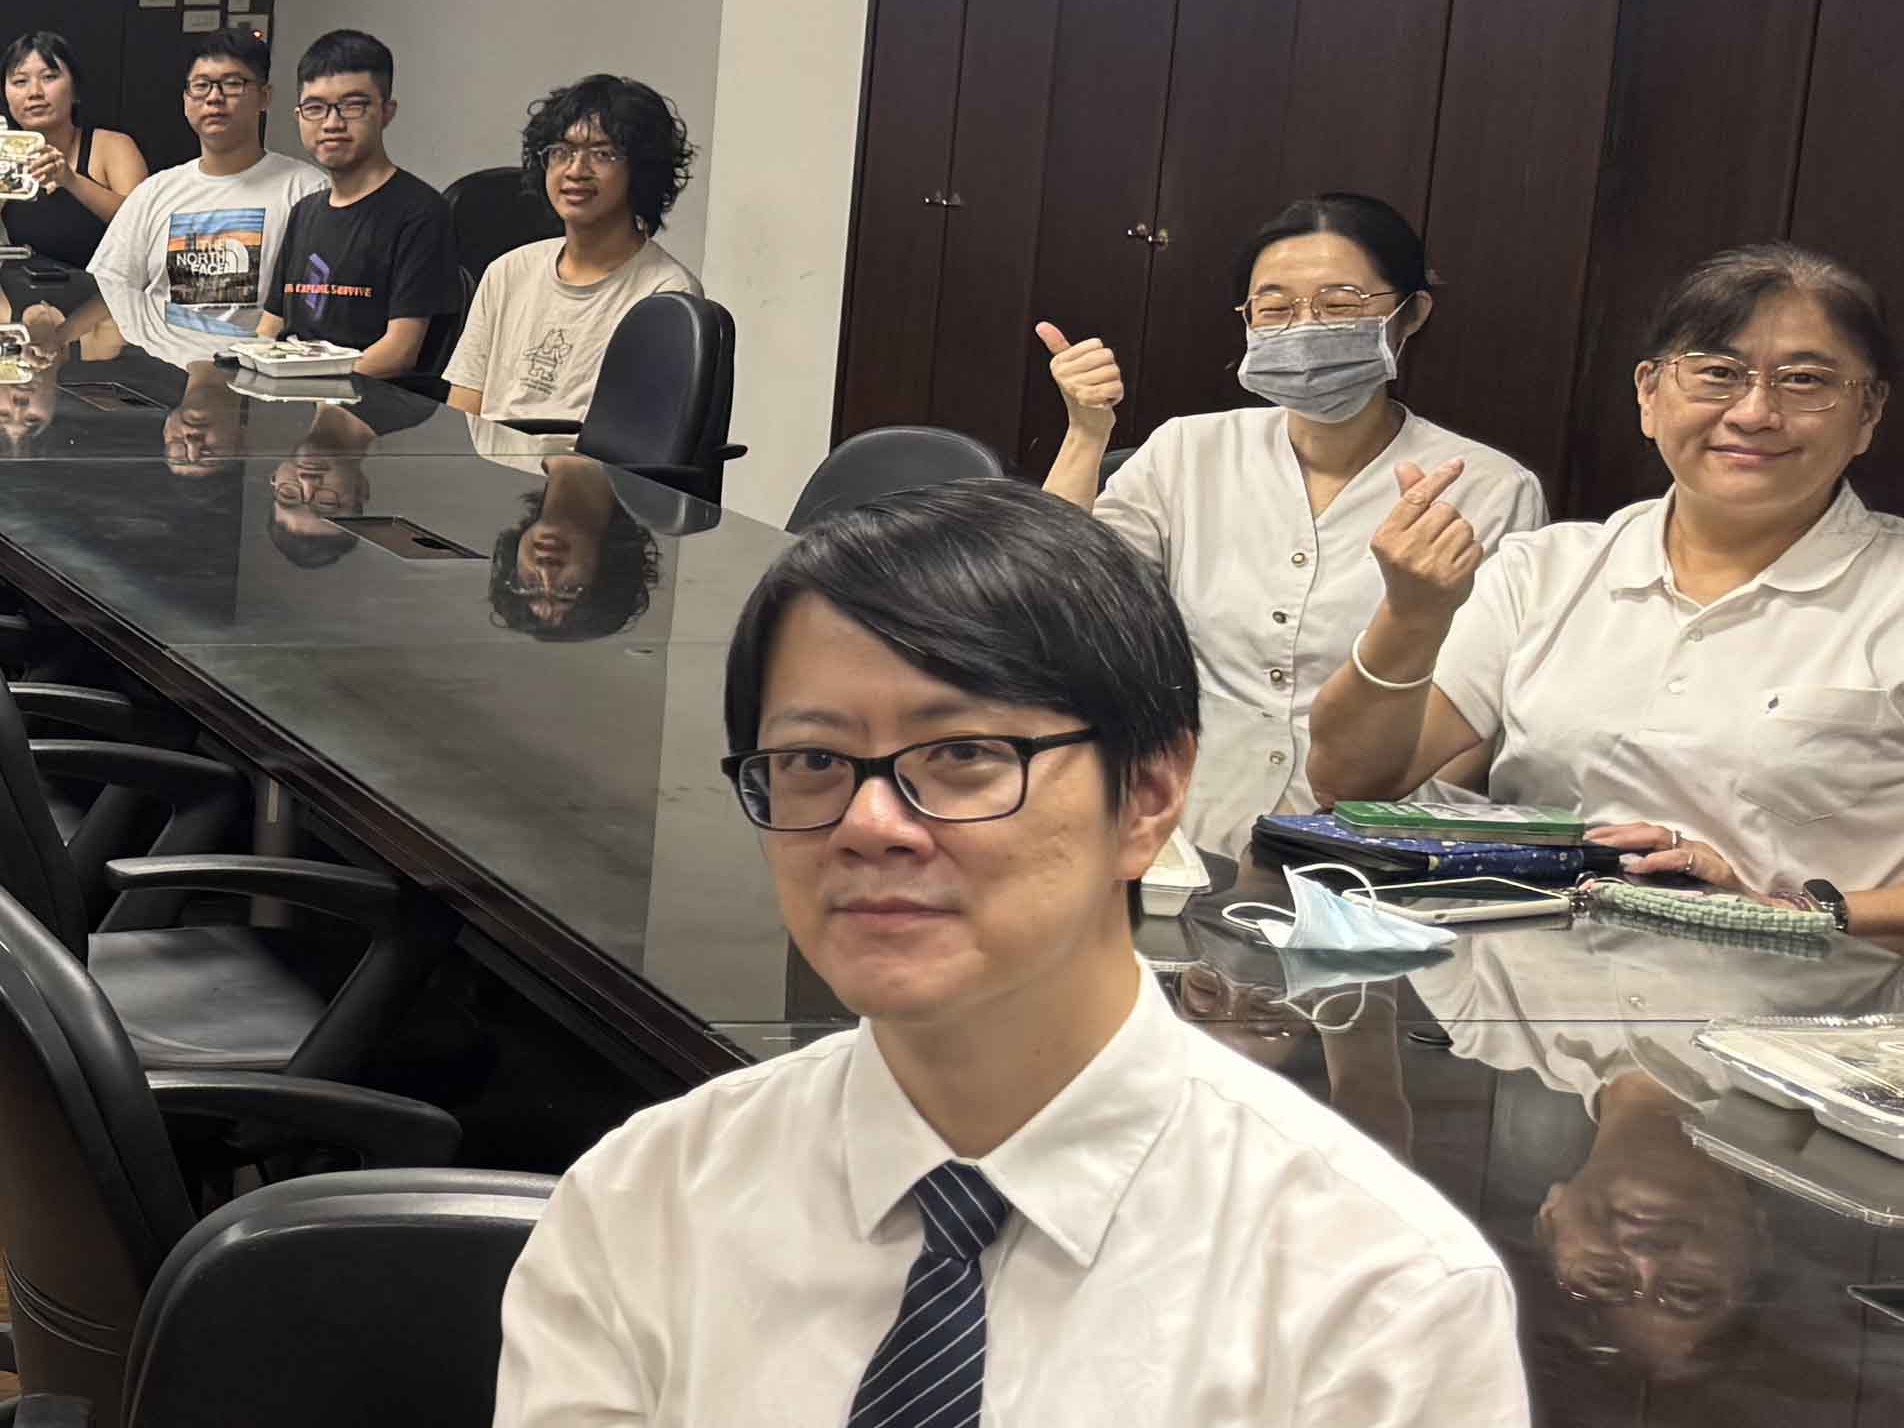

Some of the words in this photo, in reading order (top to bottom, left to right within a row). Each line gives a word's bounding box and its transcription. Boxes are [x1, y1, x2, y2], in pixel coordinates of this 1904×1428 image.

[197, 239, 225, 251] THE
[176, 252, 226, 266] NORTH
[192, 263, 225, 276] FACE
